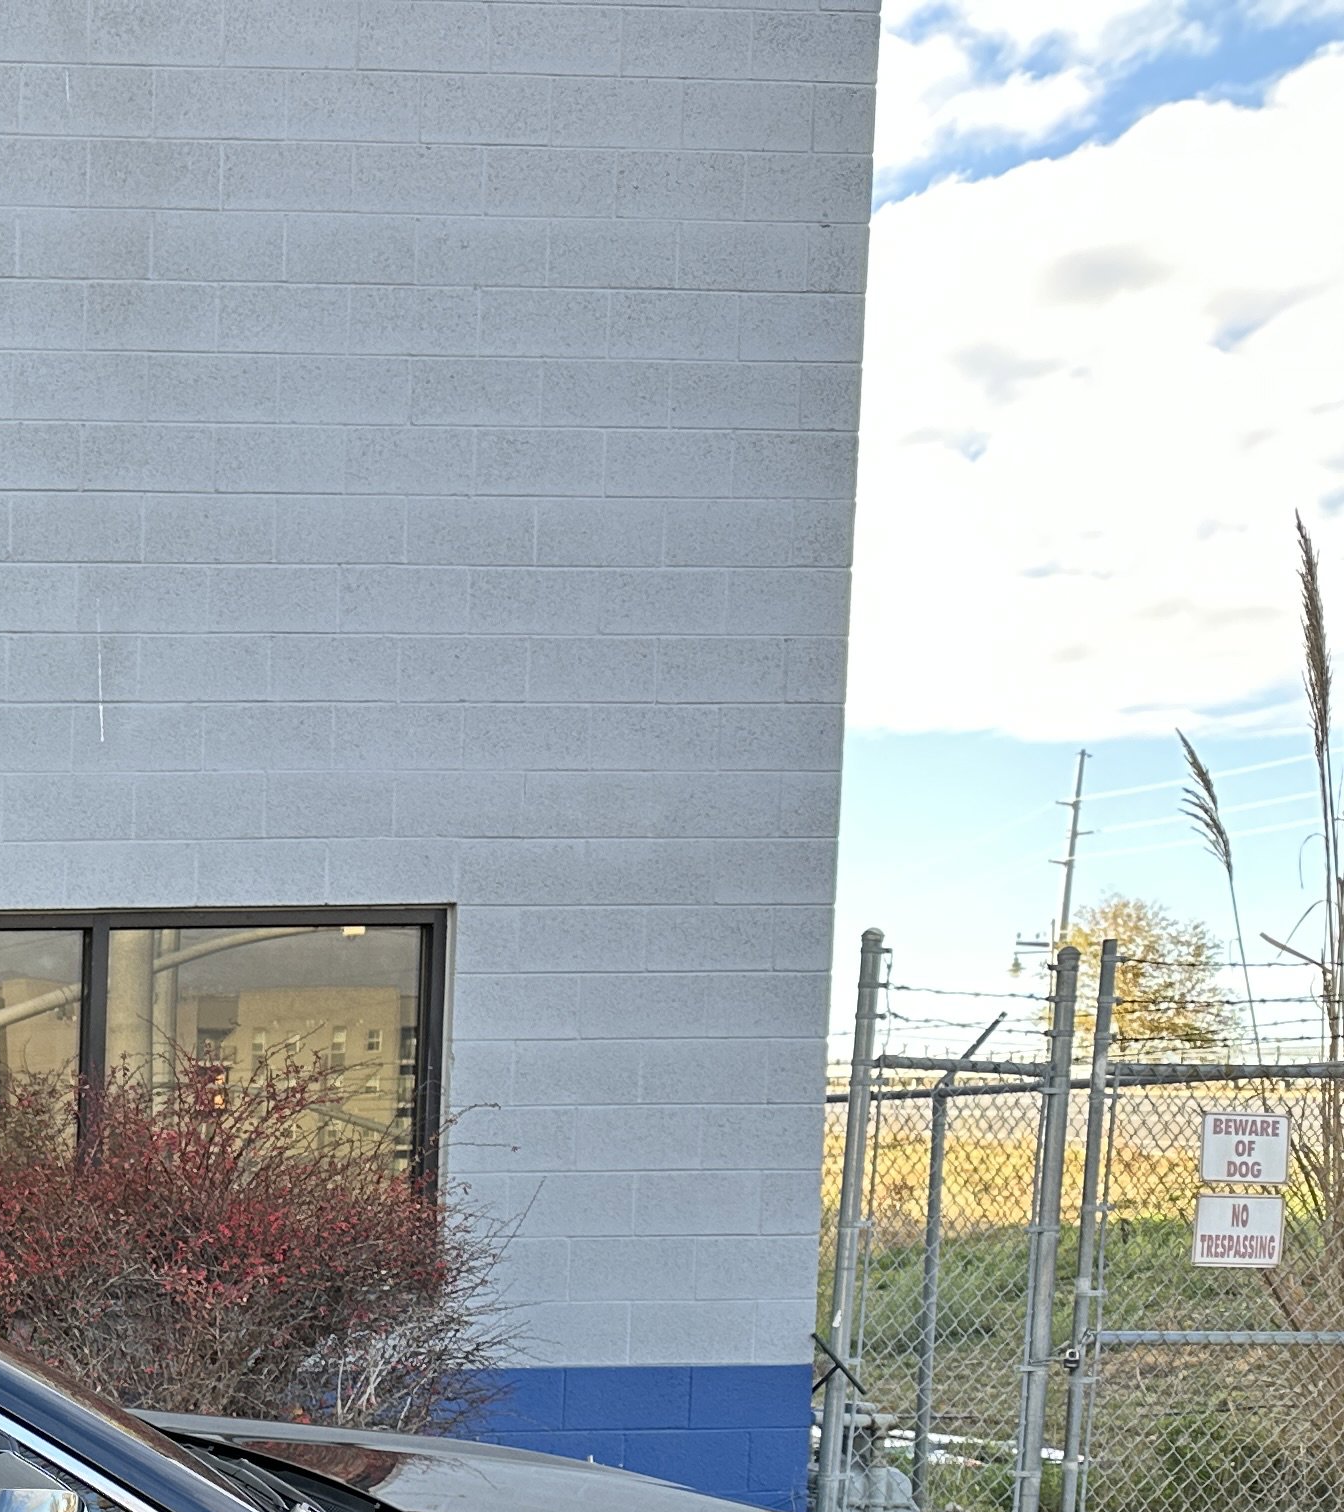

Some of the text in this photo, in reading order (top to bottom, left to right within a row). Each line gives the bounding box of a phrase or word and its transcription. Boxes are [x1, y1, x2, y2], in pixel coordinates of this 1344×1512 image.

[1213, 1118, 1280, 1137] BEWARE
[1234, 1140, 1256, 1157] OF
[1226, 1161, 1262, 1178] DOG
[1231, 1204, 1249, 1228] NO
[1200, 1234, 1276, 1259] TRESPASSING
